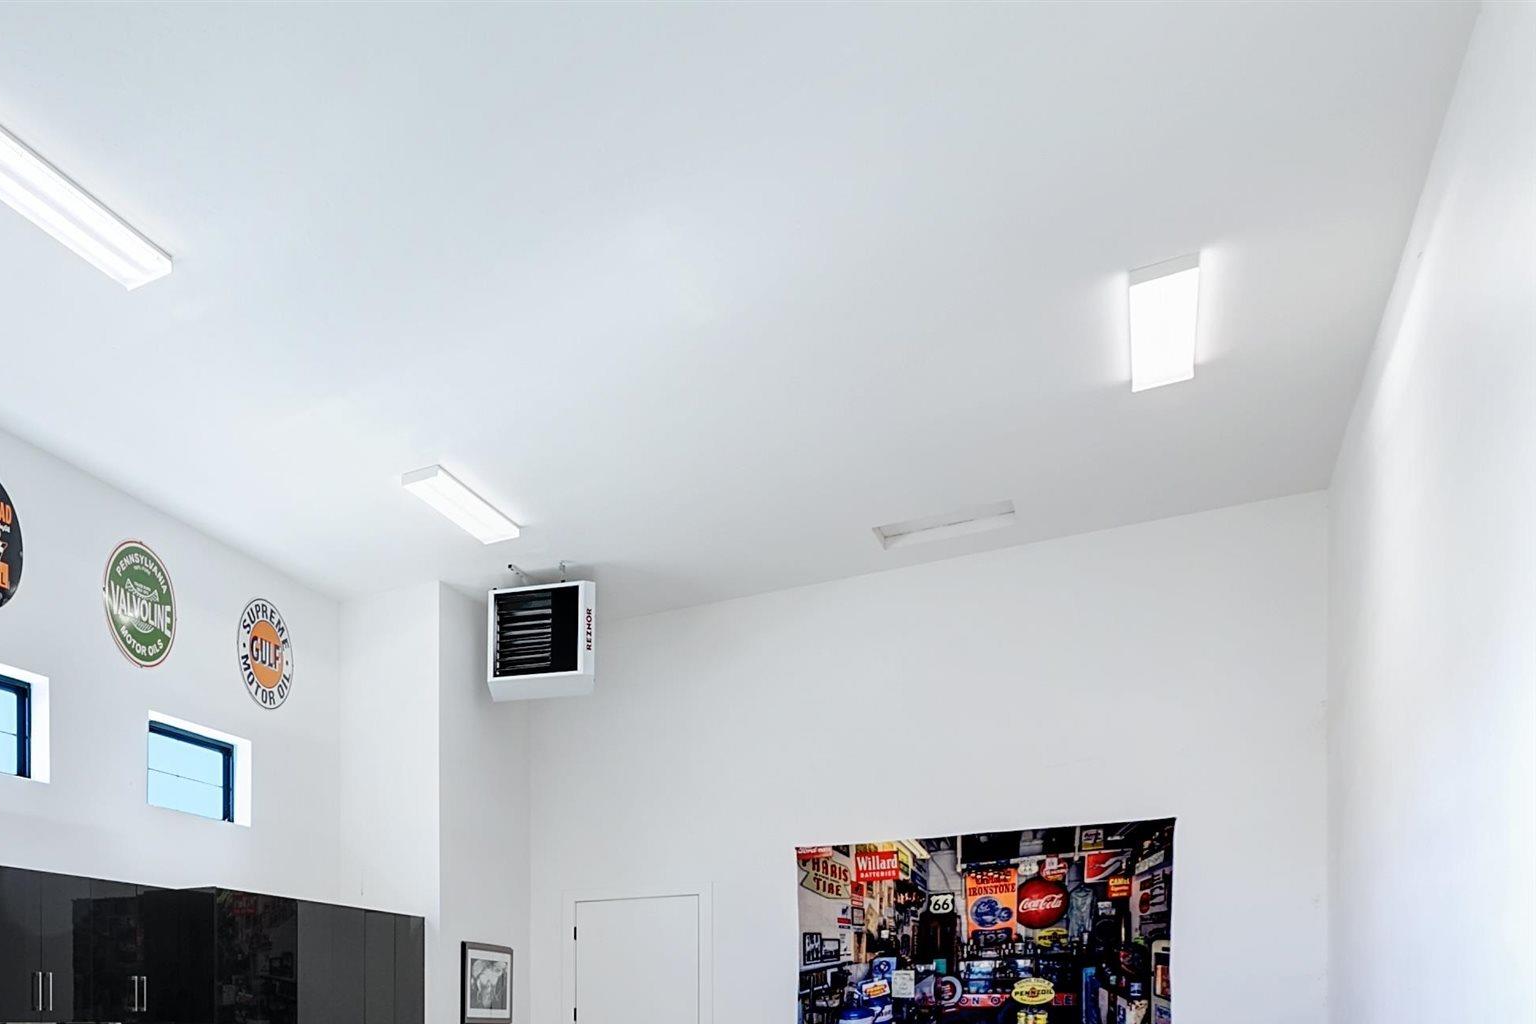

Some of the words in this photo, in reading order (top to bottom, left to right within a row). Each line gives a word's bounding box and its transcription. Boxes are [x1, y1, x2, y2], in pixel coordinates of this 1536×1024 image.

[116, 553, 167, 594] PENNSYLVANIA
[110, 580, 171, 638] VALVOLINE
[120, 625, 147, 656] MOTOR
[147, 639, 163, 656] OILS
[243, 603, 289, 651] SUPREME
[251, 635, 280, 669] GULF
[241, 654, 275, 705] MOTOR
[277, 674, 291, 699] OIL
[856, 854, 898, 871] Willard
[813, 876, 842, 896] TIRE
[968, 883, 1016, 897] IRONSTONE
[933, 898, 950, 911] 66
